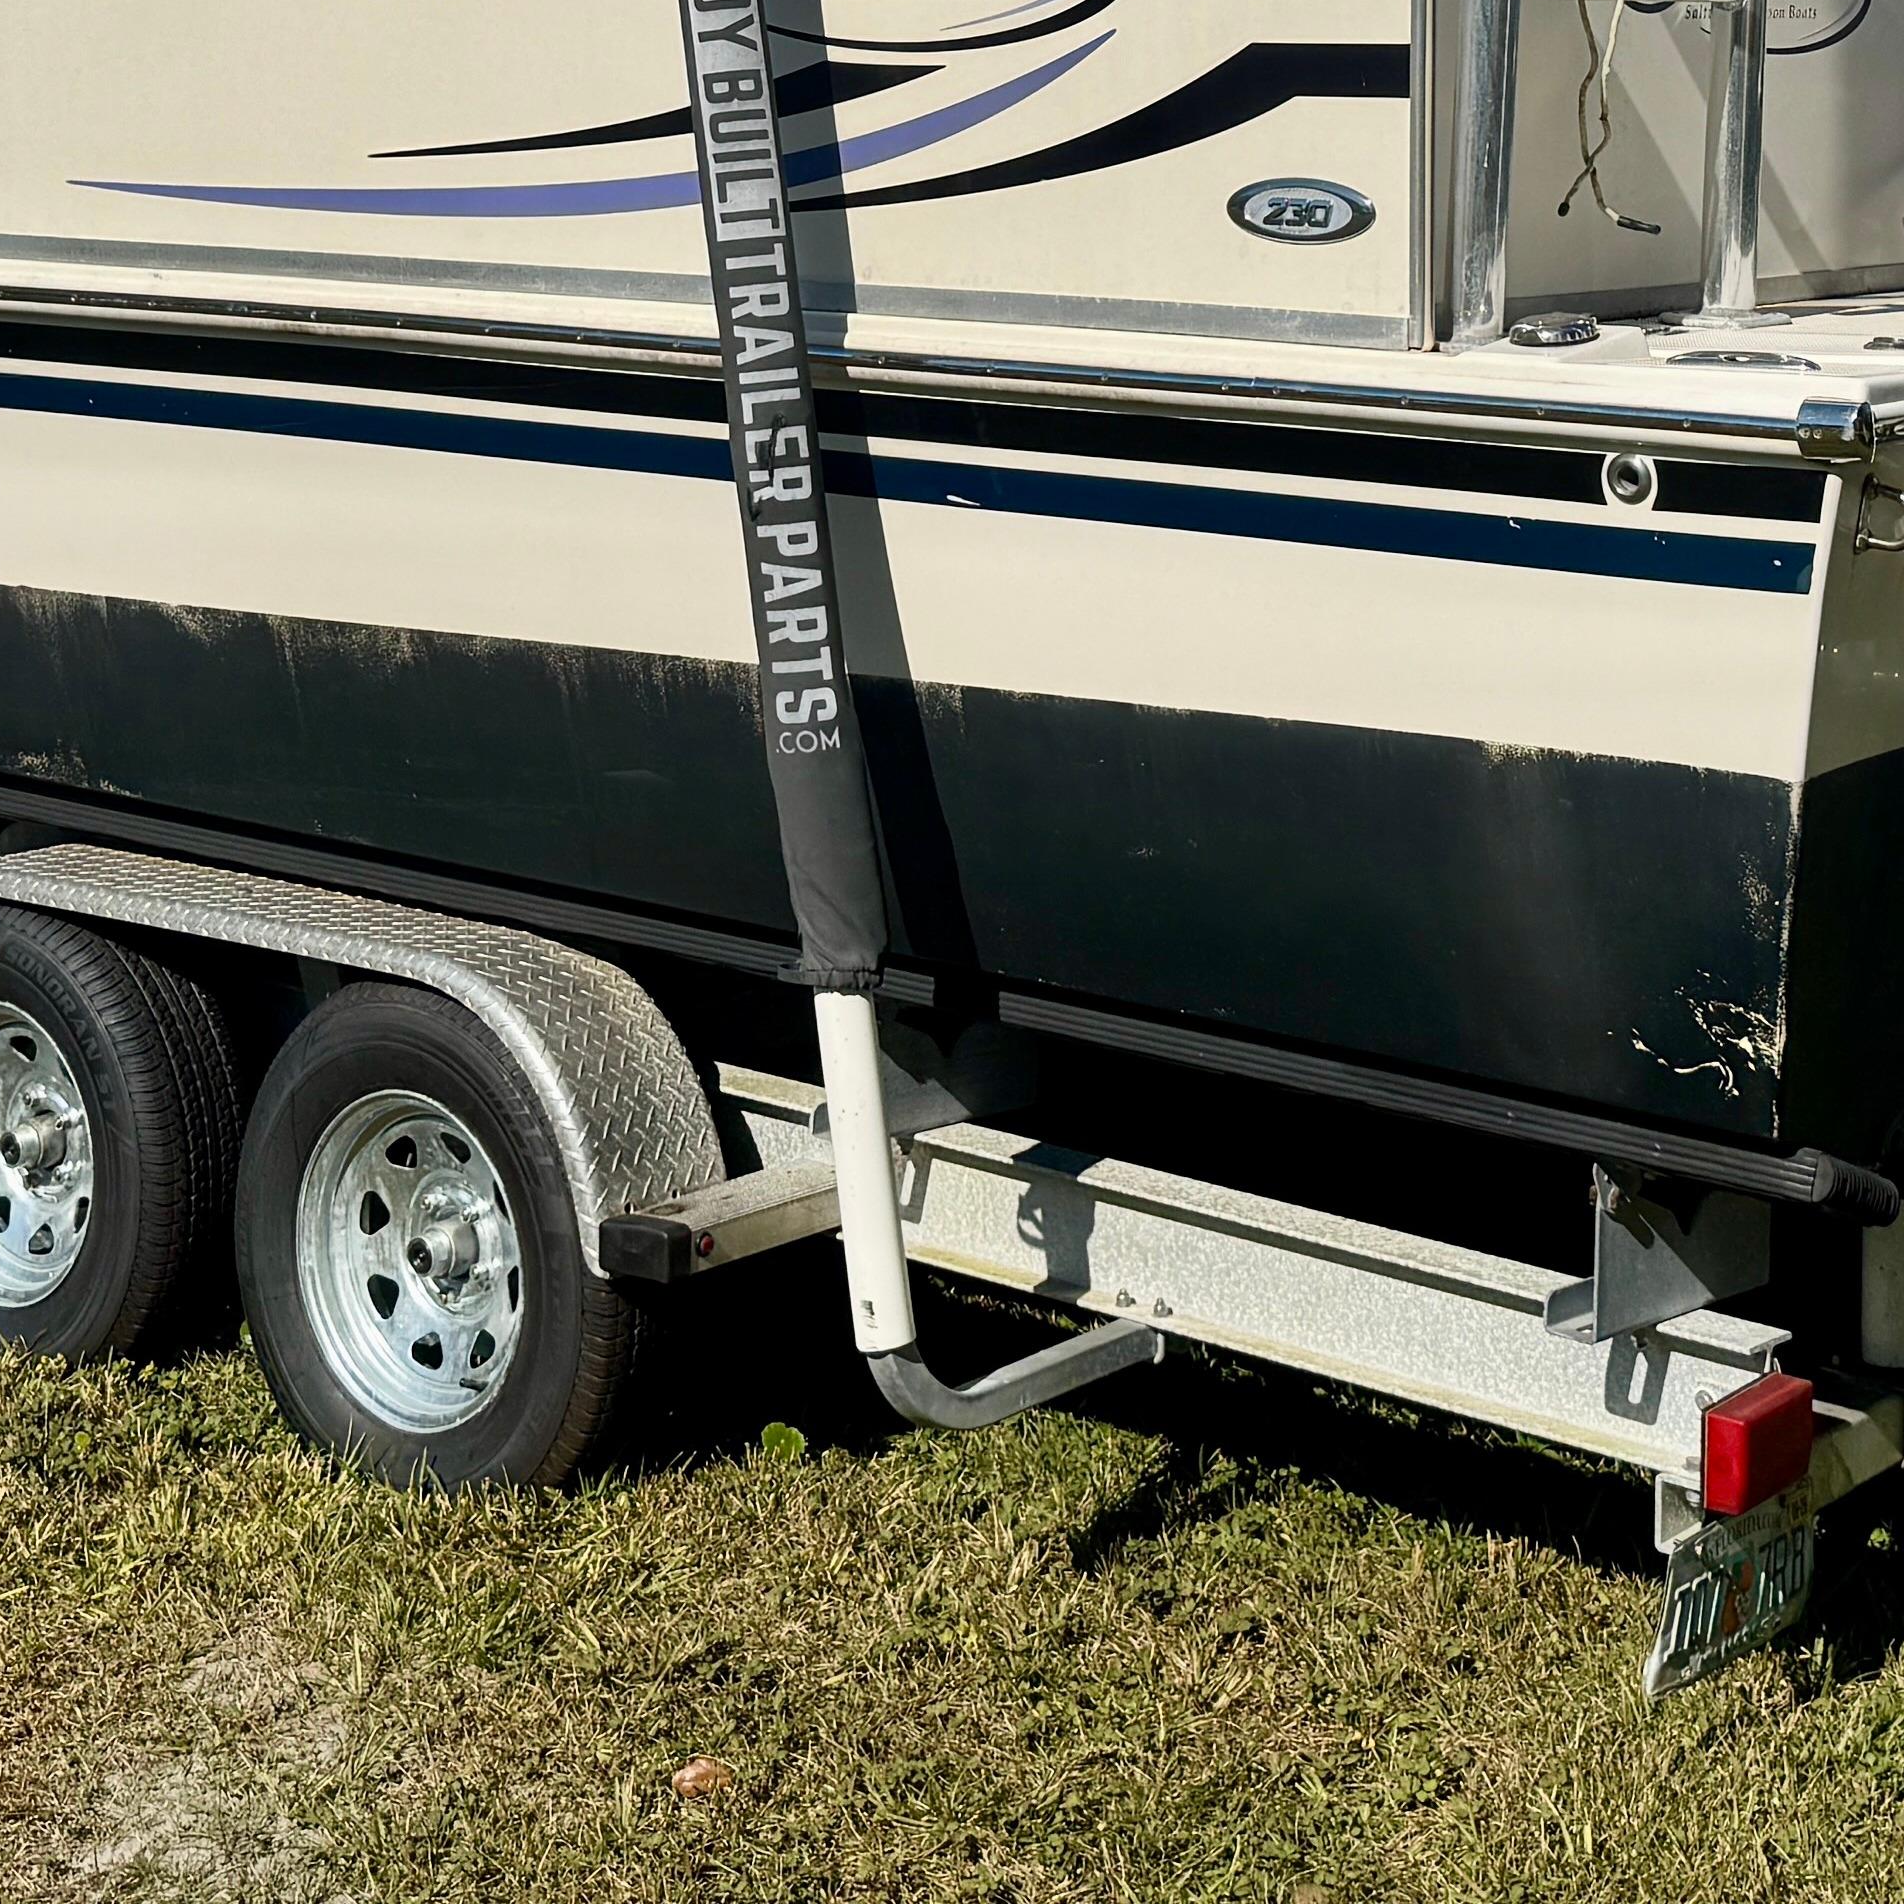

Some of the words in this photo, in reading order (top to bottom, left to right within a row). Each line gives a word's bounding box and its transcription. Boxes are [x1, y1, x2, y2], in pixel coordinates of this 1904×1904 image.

[702, 68, 780, 230] BUILT
[1262, 197, 1334, 228] 230
[725, 242, 813, 504] TRAILER
[756, 519, 839, 725] PARTS
[776, 726, 841, 754] .COM
[2, 942, 103, 1061] SONORAN
